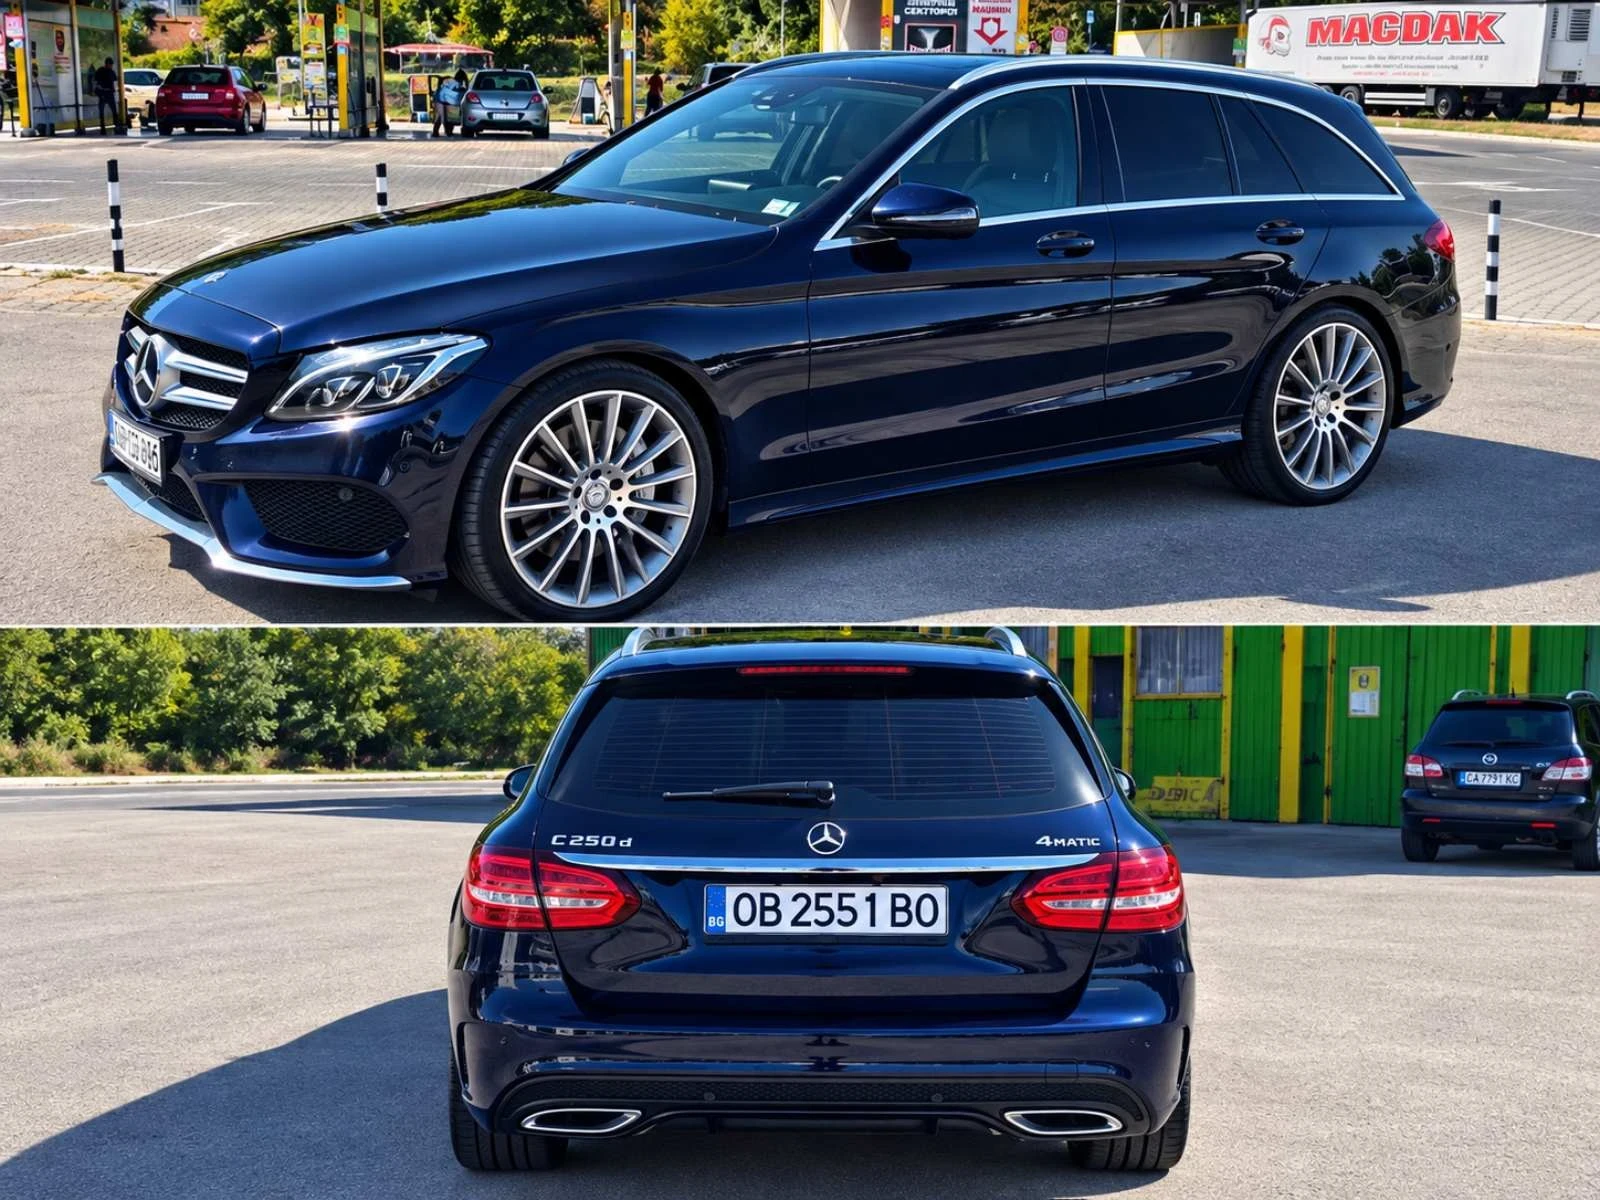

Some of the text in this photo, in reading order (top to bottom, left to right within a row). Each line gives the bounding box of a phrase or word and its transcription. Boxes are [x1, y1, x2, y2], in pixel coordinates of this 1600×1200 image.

[551, 834, 633, 847] C 250 d
[1035, 835, 1100, 847] 4MATIC
[733, 892, 939, 928] OB 2551 BO
[708, 916, 725, 927] BG
